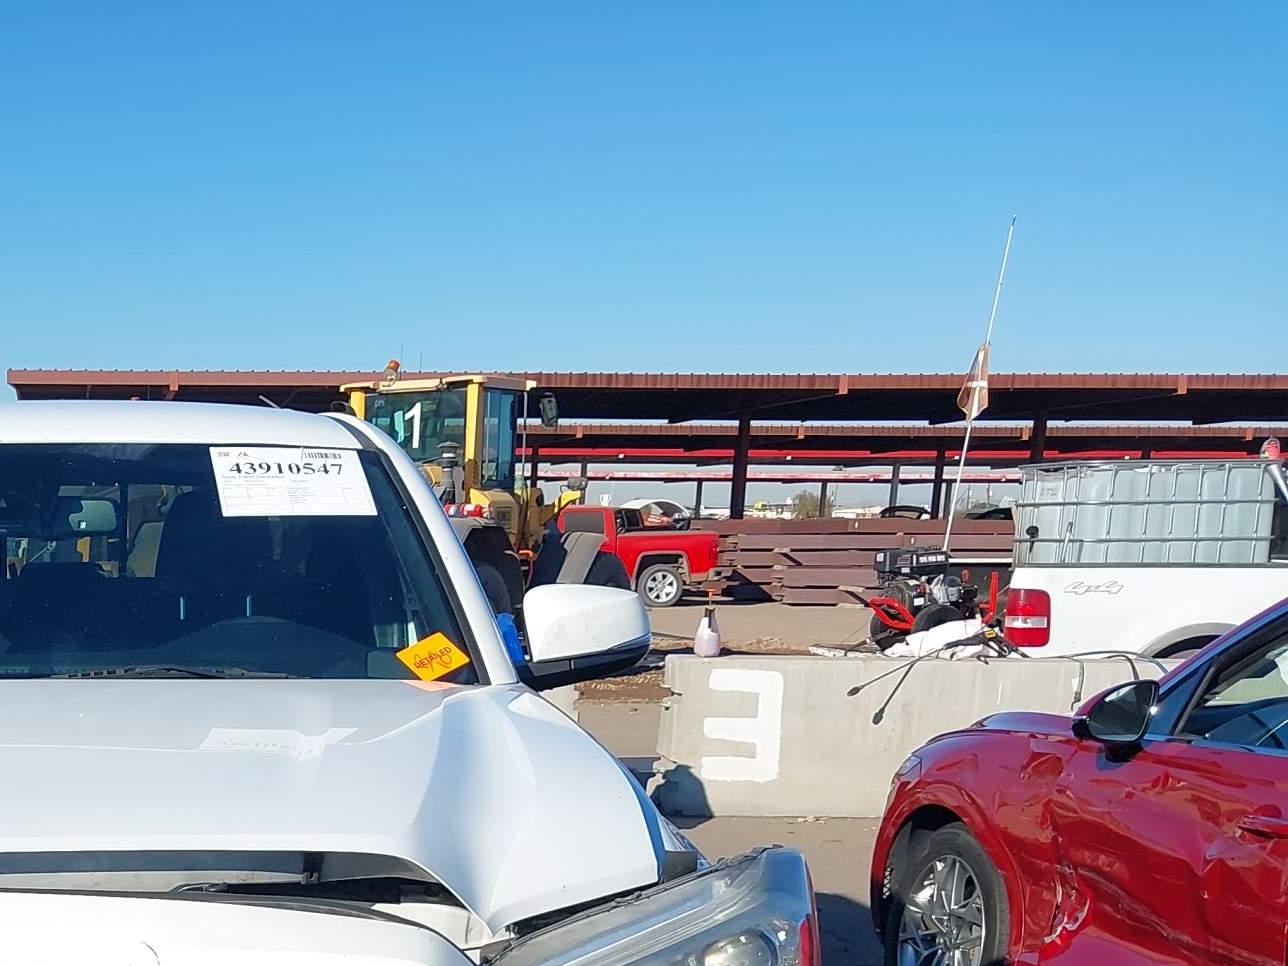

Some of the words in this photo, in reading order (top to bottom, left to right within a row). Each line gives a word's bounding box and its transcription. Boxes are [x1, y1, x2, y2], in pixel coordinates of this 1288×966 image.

[404, 401, 422, 449] 1
[229, 462, 343, 476] 43910547
[1063, 579, 1125, 595] 4x4
[701, 668, 784, 784] 3
